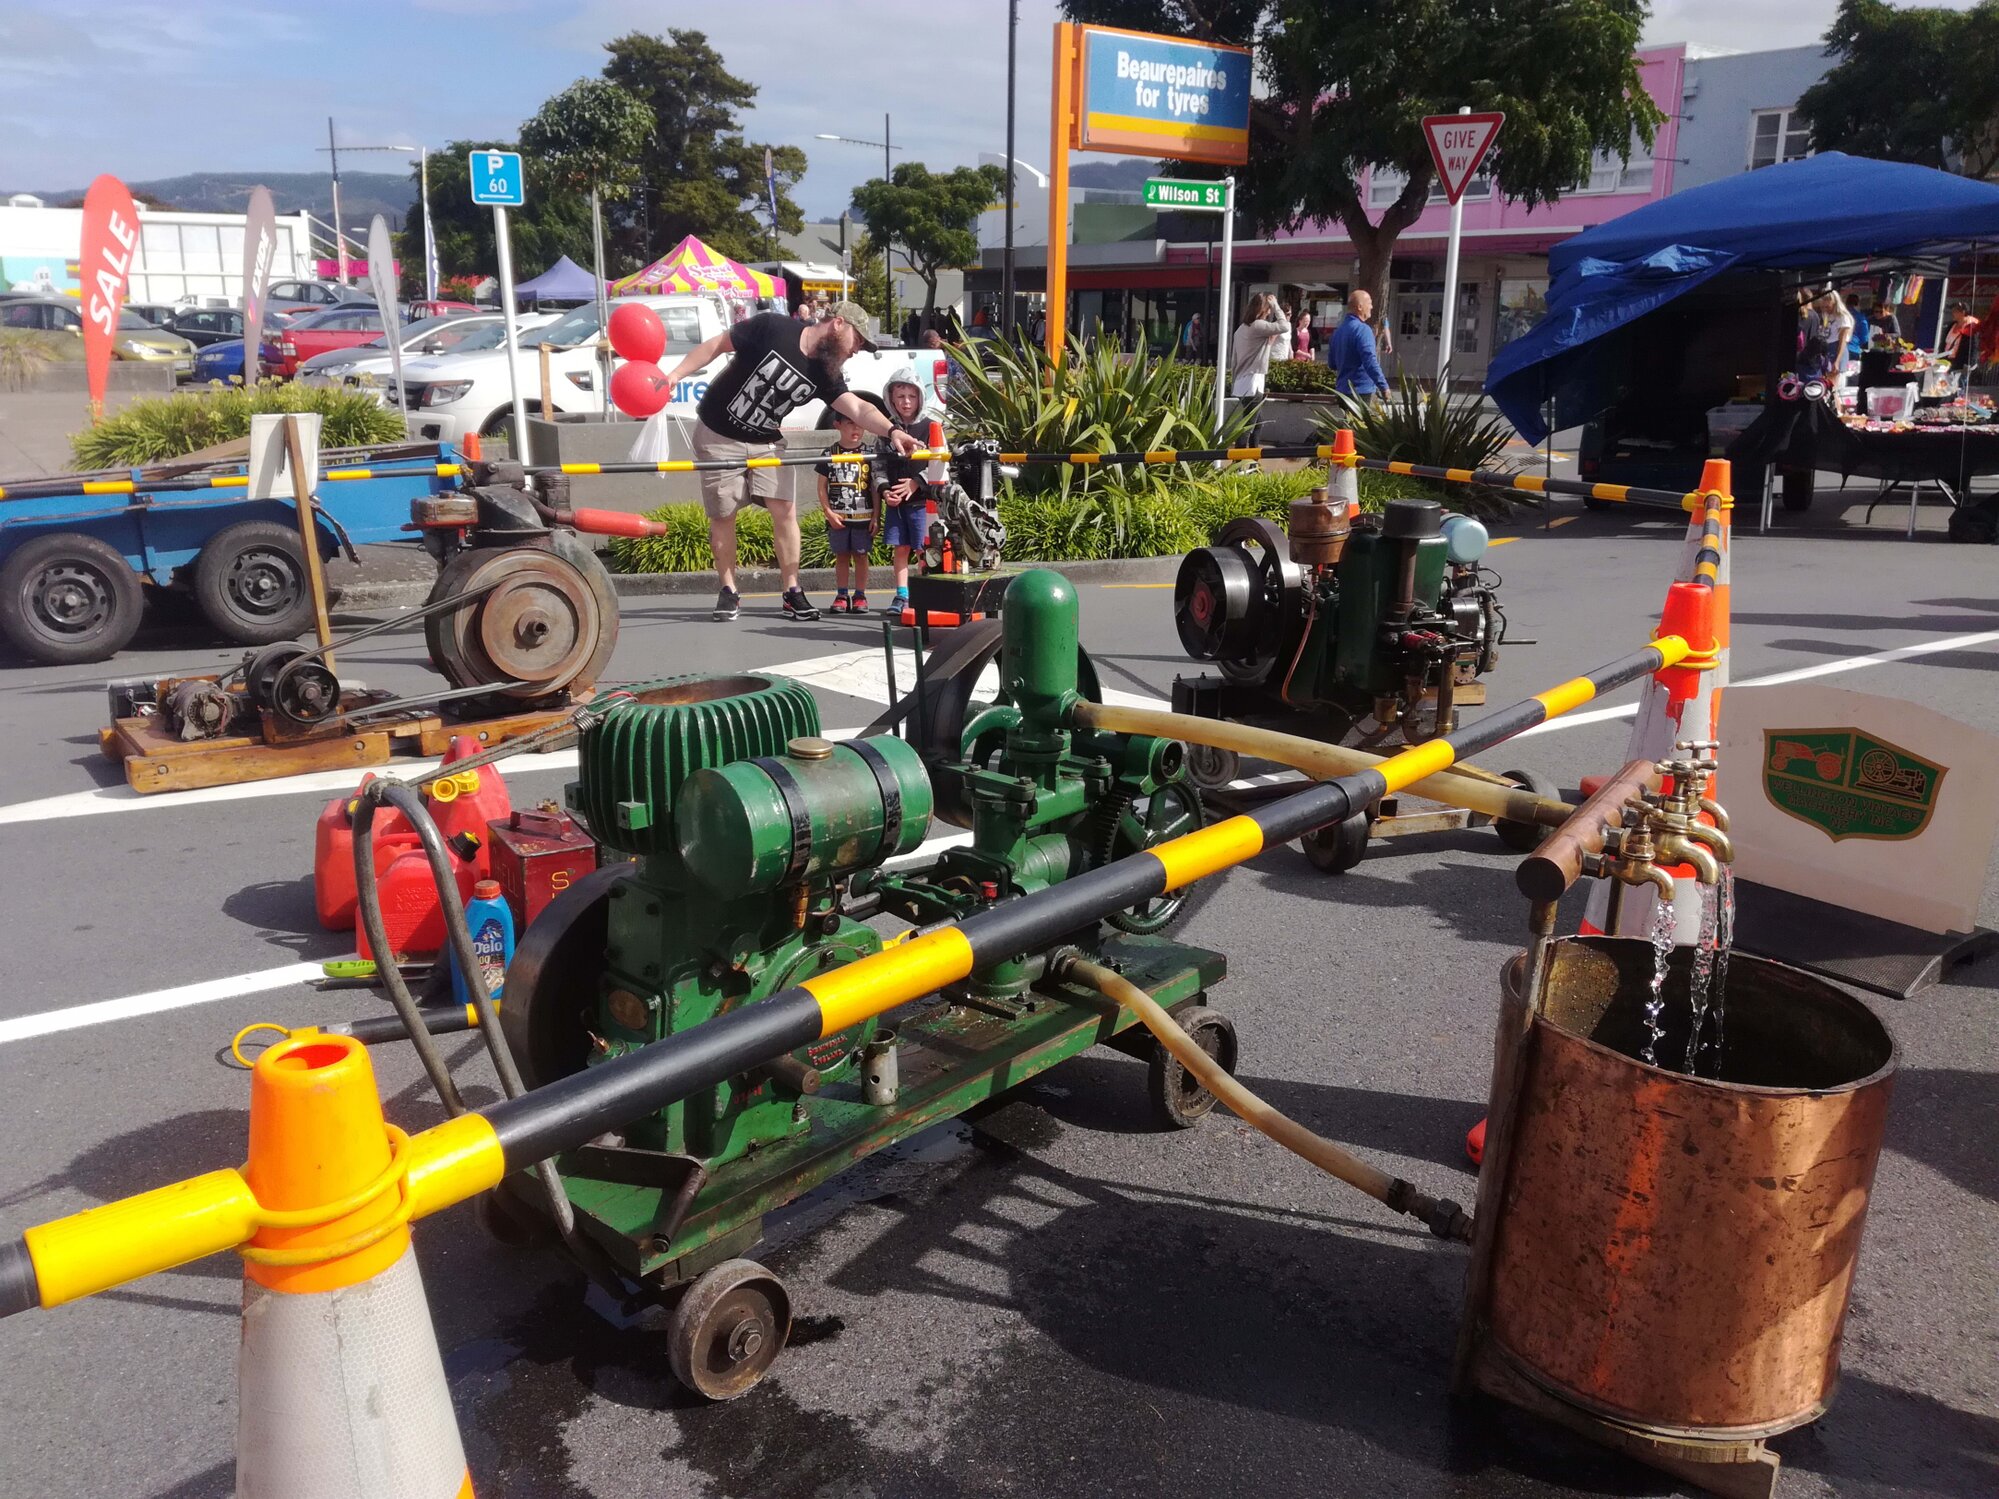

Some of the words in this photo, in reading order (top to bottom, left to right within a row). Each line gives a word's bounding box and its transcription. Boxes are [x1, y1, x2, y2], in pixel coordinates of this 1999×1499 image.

[1117, 51, 1227, 90] Beaurepaires
[1135, 80, 1160, 108] for
[1167, 86, 1209, 117] tyres
[1444, 130, 1476, 149] GIVE
[487, 155, 504, 175] P
[1448, 156, 1468, 171] WAY
[489, 178, 507, 193] 60
[1158, 185, 1199, 202] Wilson
[1205, 188, 1220, 204] St
[90, 210, 135, 336] SALE
[758, 357, 811, 402] AUC
[1772, 778, 1858, 807] WELLINGTON
[1861, 799, 1921, 821] VINTAGE
[1787, 793, 1866, 822] MACHINERY
[1830, 817, 1849, 829] NZ
[473, 941, 503, 955] Delo
